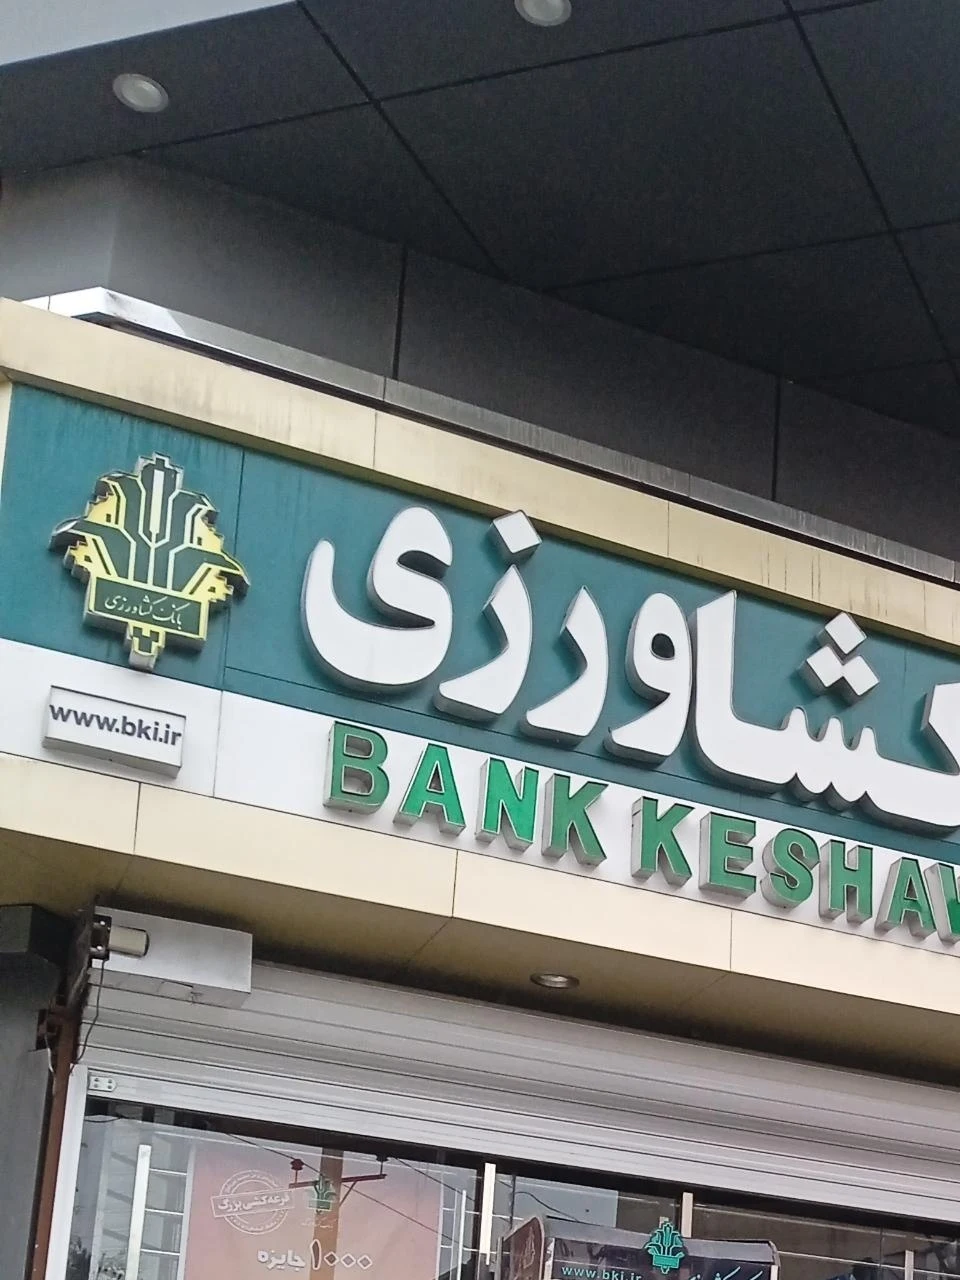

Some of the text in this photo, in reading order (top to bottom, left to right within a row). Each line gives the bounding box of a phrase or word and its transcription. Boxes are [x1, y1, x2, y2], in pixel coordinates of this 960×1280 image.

[104, 594, 191, 630] بانک کشاورزی
[49, 704, 182, 746] www.bki.ir
[324, 721, 609, 866] BANK
[257, 1239, 373, 1271] ۱۰۰۰ جایزه
